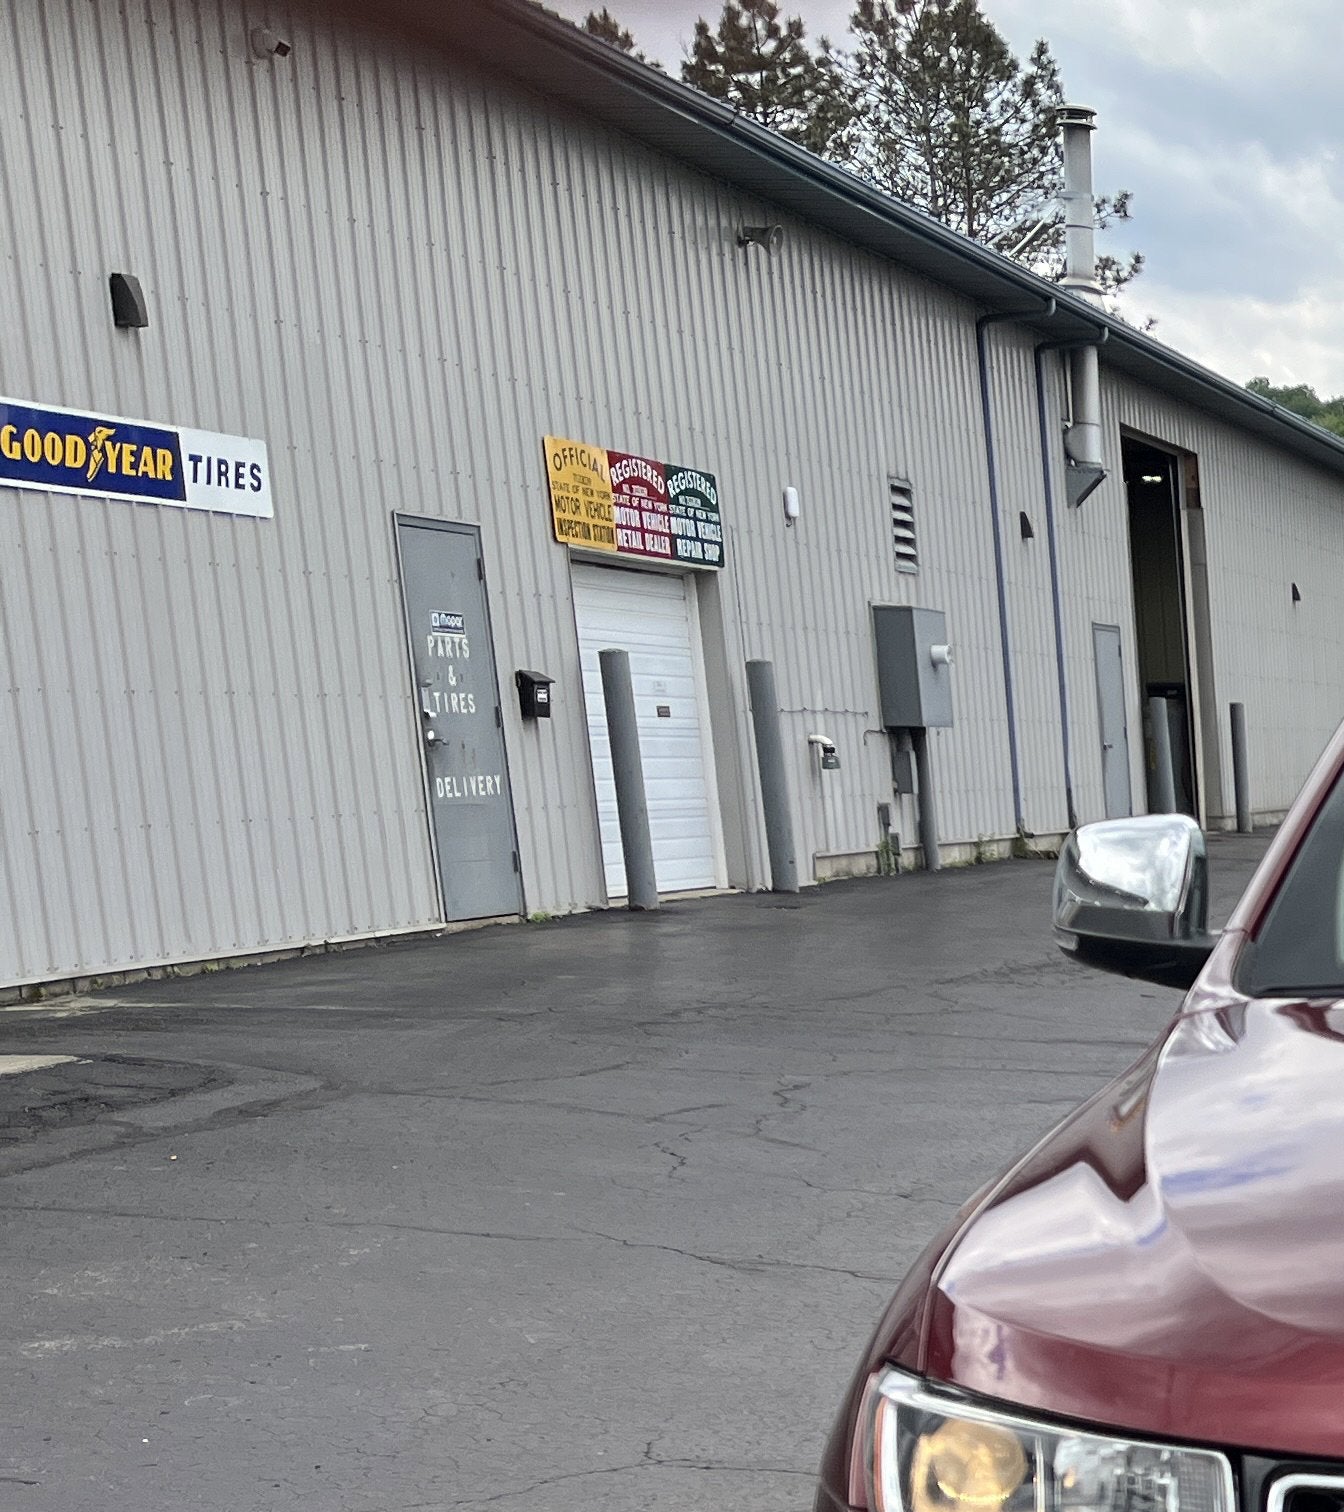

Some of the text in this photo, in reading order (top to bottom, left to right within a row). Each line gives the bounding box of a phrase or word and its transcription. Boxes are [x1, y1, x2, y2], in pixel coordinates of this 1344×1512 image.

[188, 453, 262, 493] TIRES
[553, 447, 605, 484] OFFICIAL
[610, 458, 665, 495] REGISTERED
[667, 470, 717, 506] REGISTERED
[554, 494, 612, 523] MOTOR VEHICLE
[613, 505, 670, 534] MOTOR VEHICLE
[617, 528, 671, 555] RETAIL DEALER
[670, 516, 722, 543] MOTOR VEHICLE
[677, 538, 720, 563] REPAIR SHOP
[427, 635, 470, 659] PARTS
[449, 665, 457, 686] &
[433, 692, 476, 714] TIRES
[436, 775, 501, 798] DELIVERY
